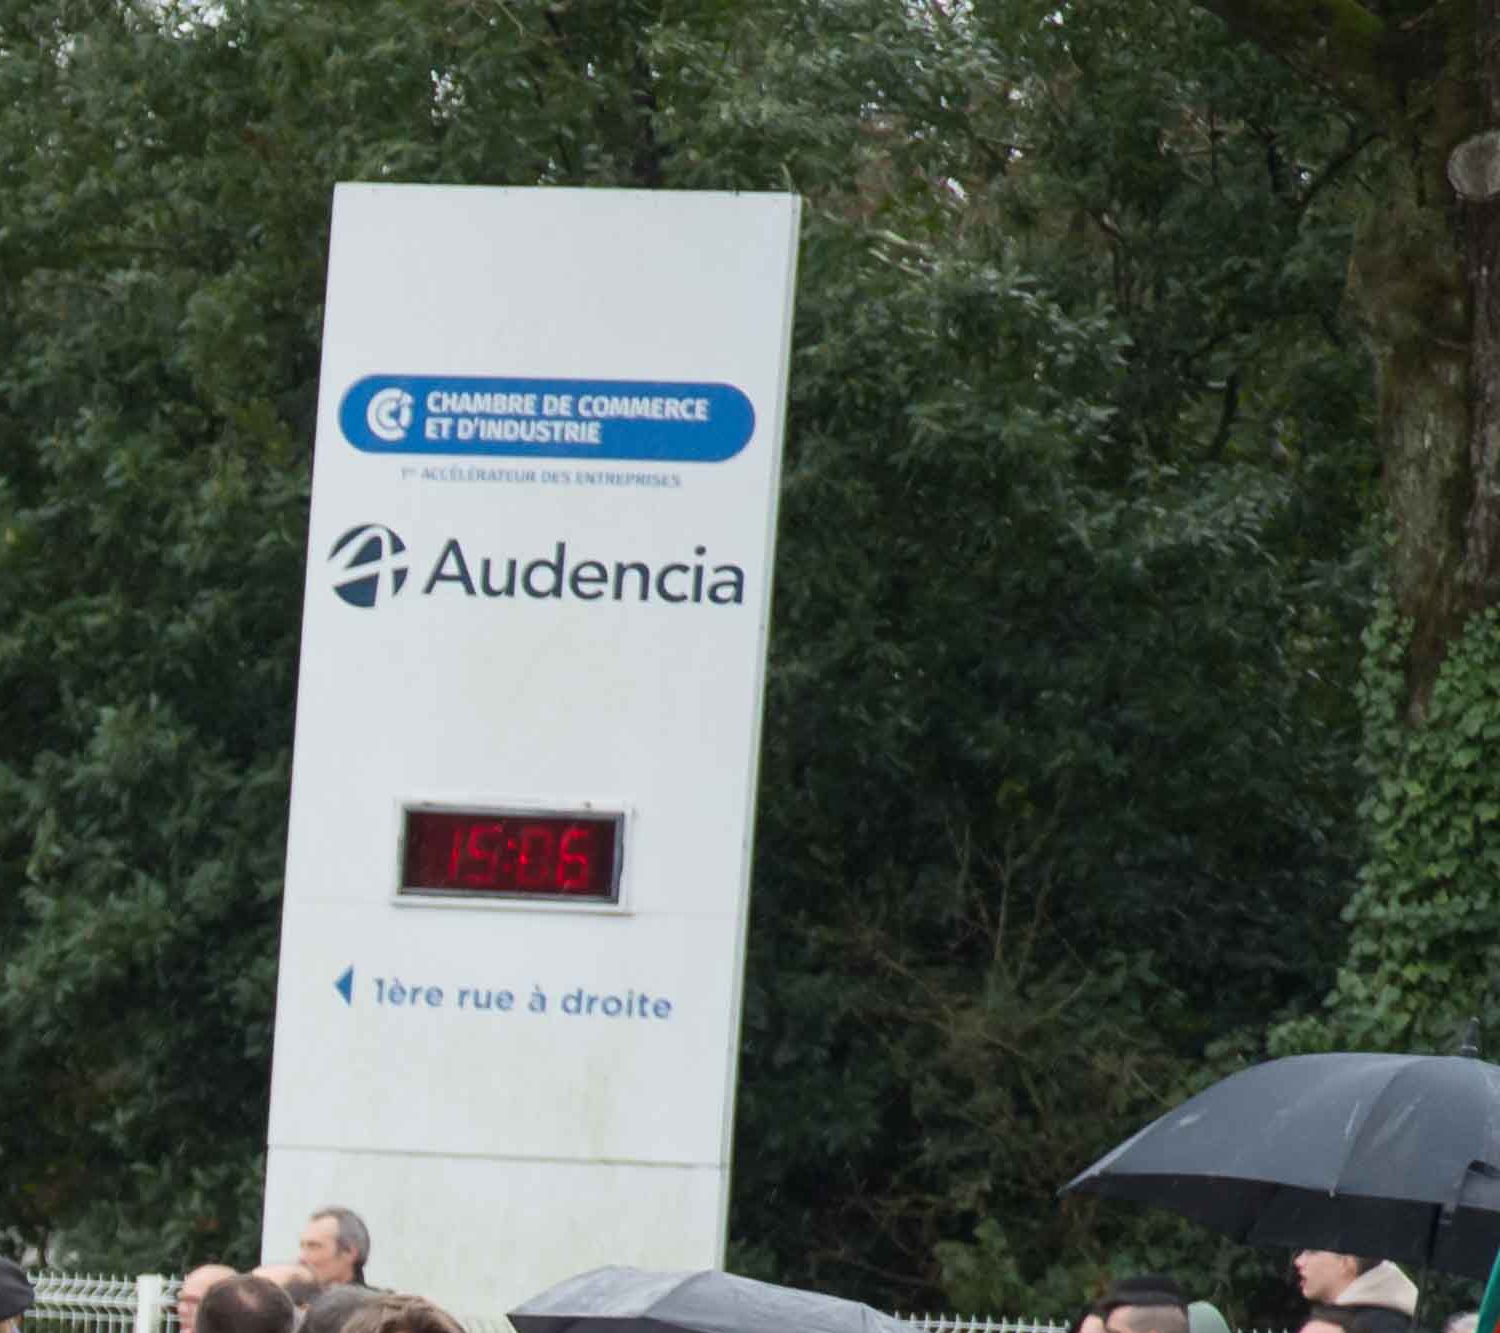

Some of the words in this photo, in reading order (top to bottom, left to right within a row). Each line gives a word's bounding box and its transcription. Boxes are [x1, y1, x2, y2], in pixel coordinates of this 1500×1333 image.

[426, 391, 537, 416] CHAMBRE
[544, 394, 573, 417] DE
[578, 395, 709, 421] COMMERCE
[425, 417, 453, 439] ET
[457, 418, 602, 444] D'INDUSTRIE
[540, 470, 572, 485] DES
[575, 471, 682, 488] ENTREPRISES
[423, 538, 746, 605] Audencia
[448, 823, 591, 889] 15:06
[373, 977, 444, 1007] 1ère
[457, 987, 515, 1012] rue
[527, 984, 548, 1013] à
[561, 988, 673, 1019] droite
